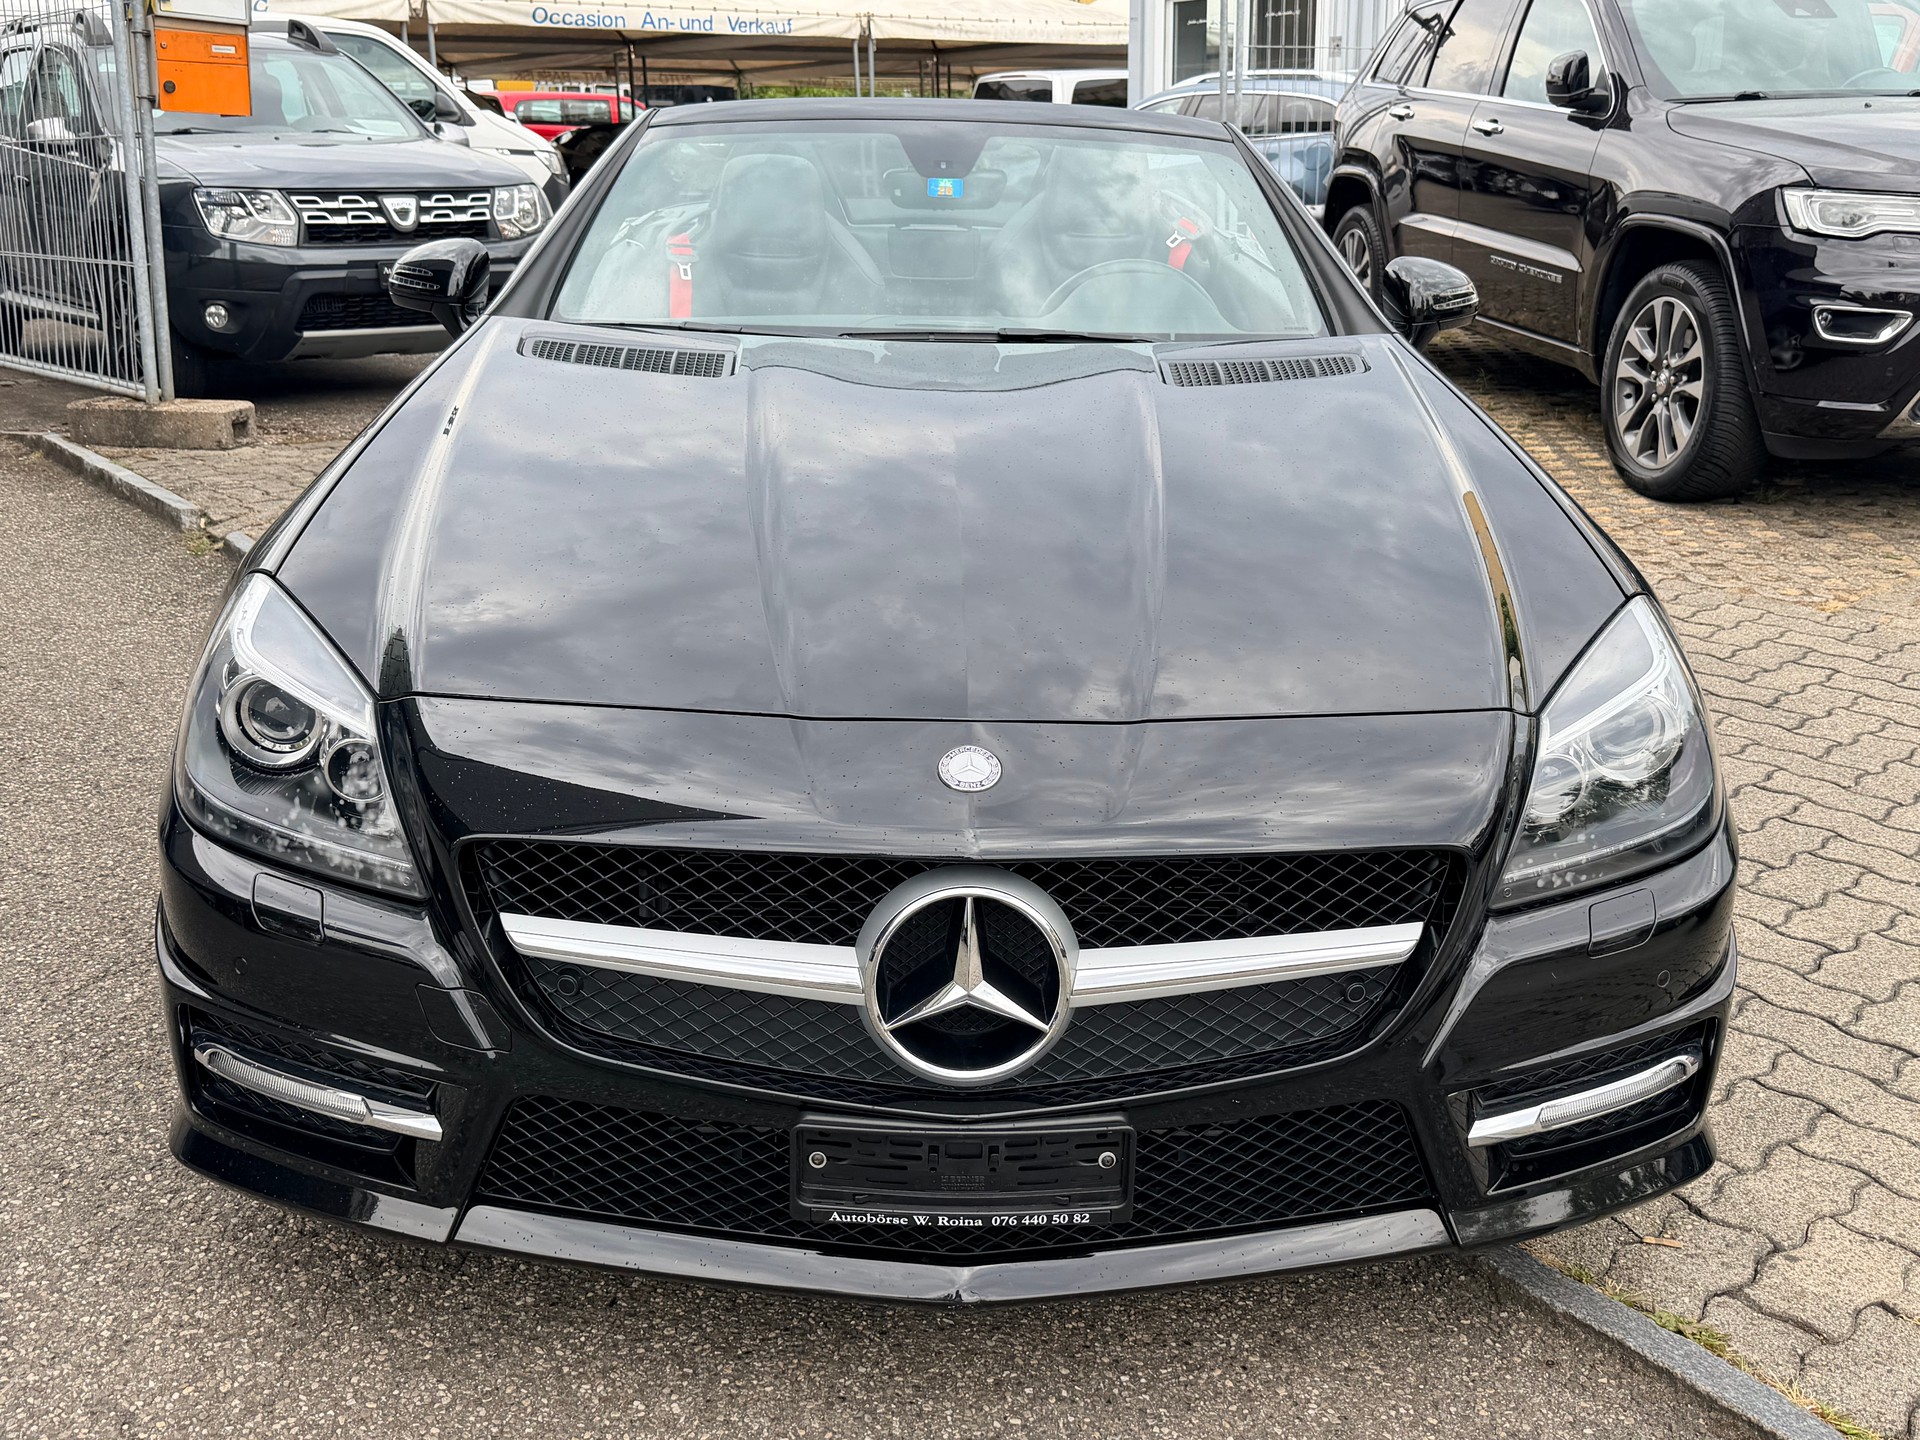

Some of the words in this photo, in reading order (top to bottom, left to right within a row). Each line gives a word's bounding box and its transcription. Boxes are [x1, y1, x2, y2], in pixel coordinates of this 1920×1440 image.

[532, 7, 626, 28] Occasion
[727, 15, 792, 34] Verkauf
[828, 1211, 909, 1225] Autobörse
[913, 1215, 932, 1226] W.
[937, 1215, 983, 1226] Roina
[991, 1215, 1018, 1226] 076
[1021, 1214, 1048, 1226] 440
[1051, 1213, 1069, 1225] 50
[1073, 1213, 1090, 1224] 82
